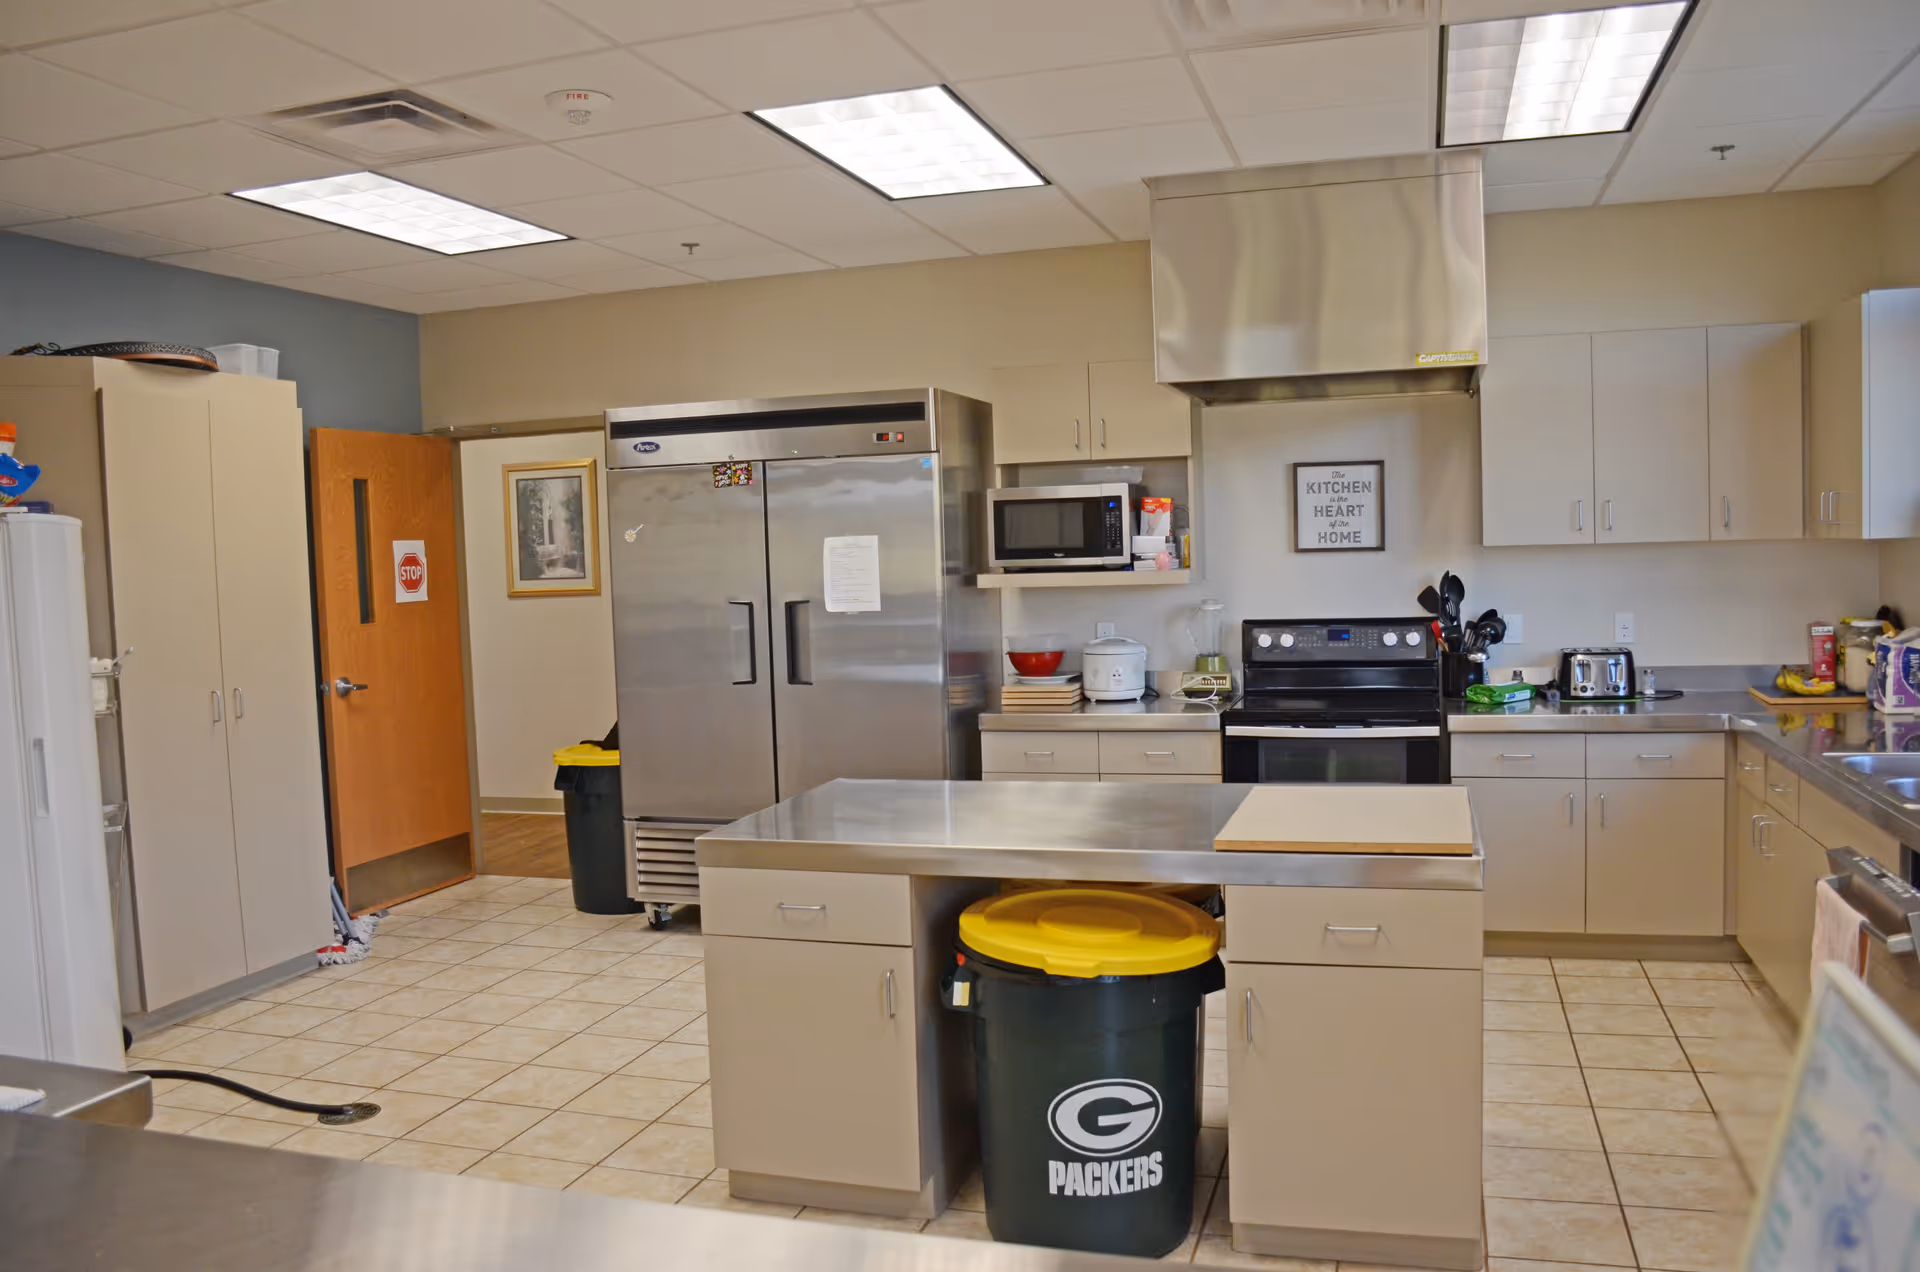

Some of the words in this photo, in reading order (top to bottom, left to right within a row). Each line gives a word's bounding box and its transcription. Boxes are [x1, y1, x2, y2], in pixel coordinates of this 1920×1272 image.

[1331, 471, 1346, 479] The
[1306, 481, 1372, 494] KITCHEN
[1336, 495, 1349, 503] the
[1313, 504, 1364, 518] HEART
[1328, 520, 1337, 529] of
[1317, 530, 1362, 544] HOME
[401, 566, 421, 580] STOP
[1055, 1085, 1156, 1150] G
[1048, 1151, 1163, 1197] PACKERS
